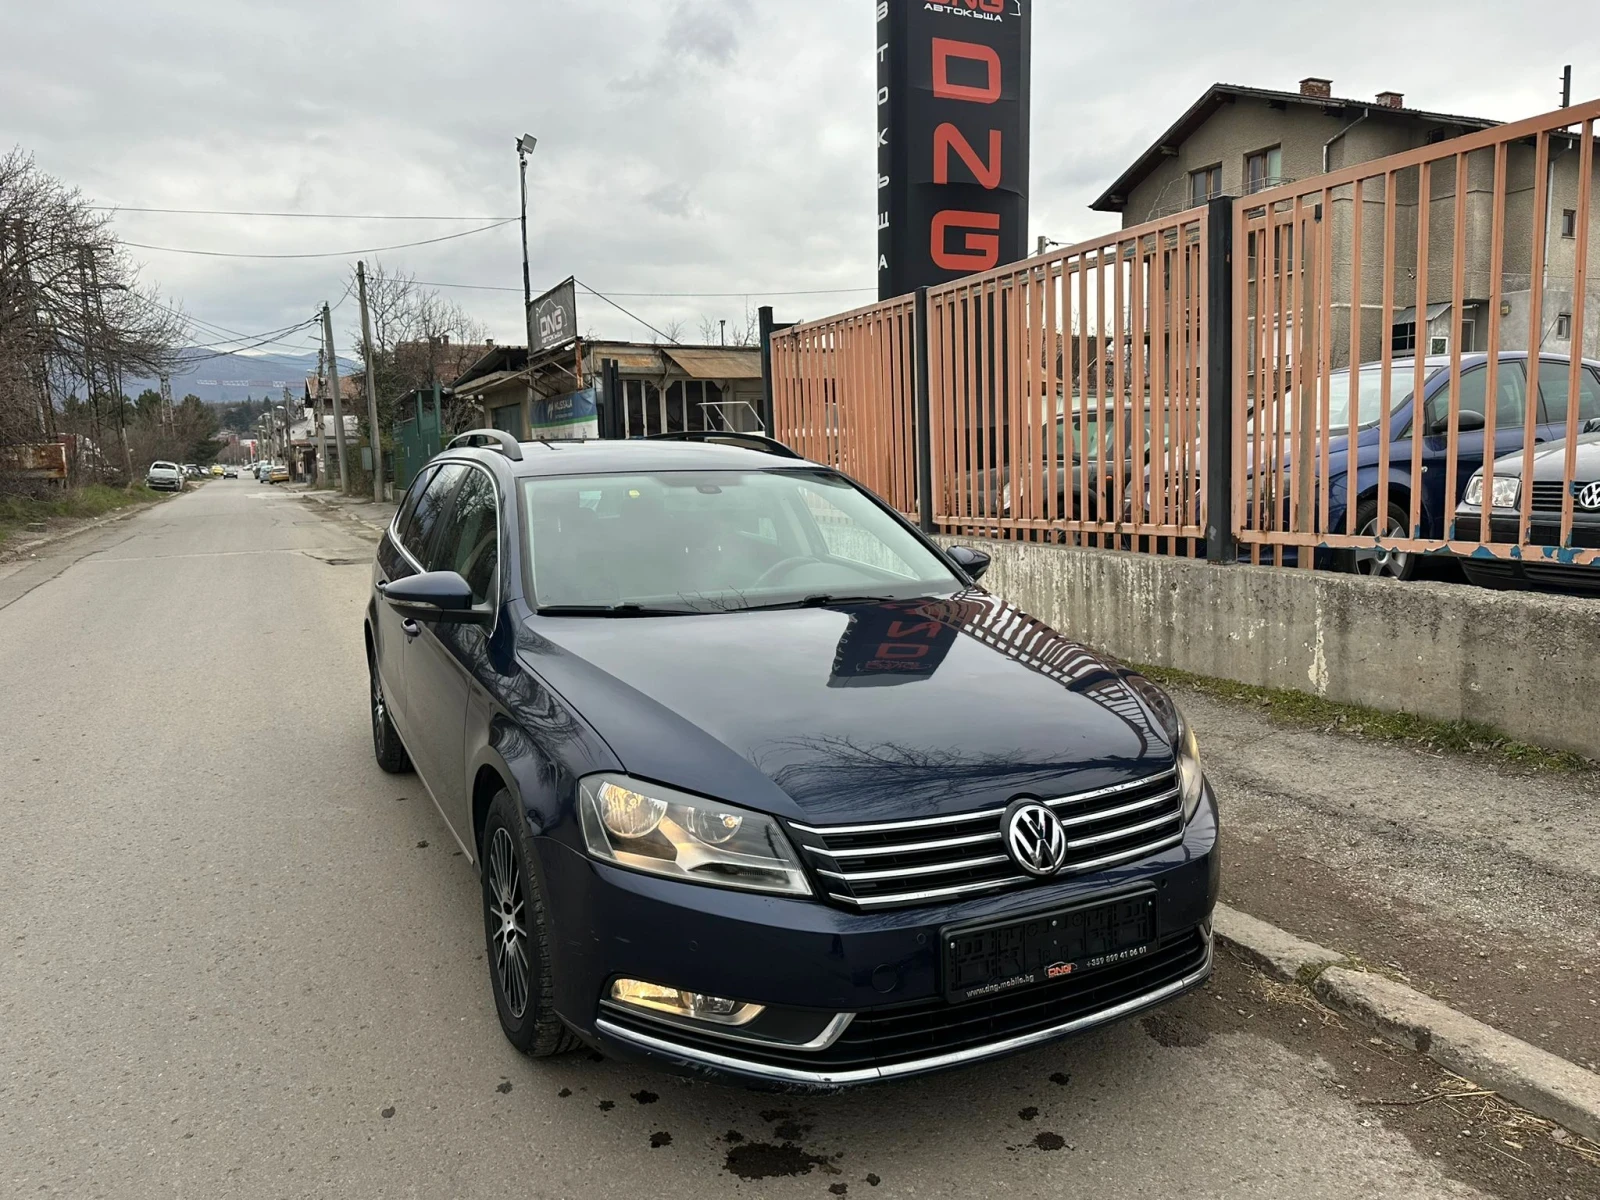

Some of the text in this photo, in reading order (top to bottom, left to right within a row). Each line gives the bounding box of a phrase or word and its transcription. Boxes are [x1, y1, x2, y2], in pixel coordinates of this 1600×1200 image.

[931, 37, 1002, 271] DNG
[540, 309, 563, 337] DNG
[1009, 804, 1066, 873] VW
[966, 974, 1035, 998] www.dng.mobile.bg
